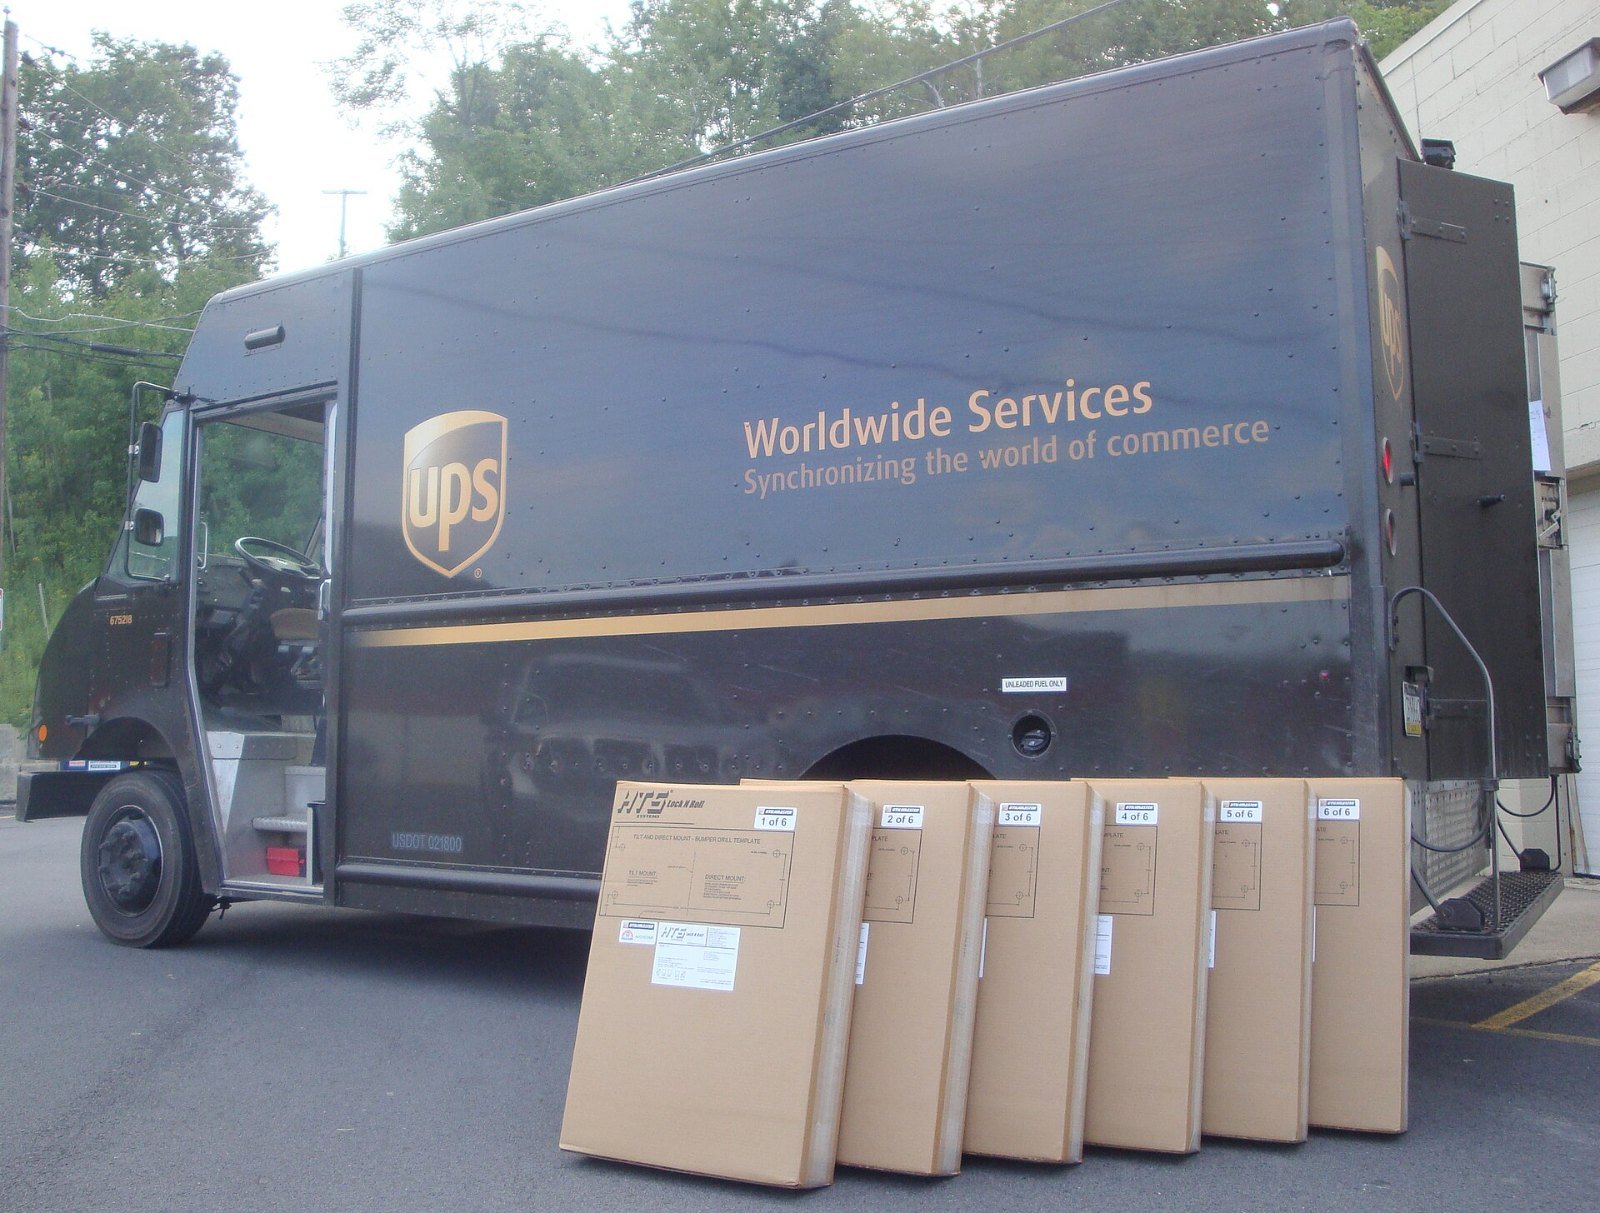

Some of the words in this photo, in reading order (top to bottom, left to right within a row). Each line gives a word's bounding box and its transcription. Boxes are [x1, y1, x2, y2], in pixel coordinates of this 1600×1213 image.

[744, 398, 952, 459] Worldwide
[967, 378, 1153, 433] Services
[744, 453, 917, 500] Synchronizing
[925, 448, 968, 475] the
[979, 435, 1057, 469] world
[1068, 429, 1097, 461] of
[1107, 420, 1270, 457] commerce
[409, 457, 499, 552] ups
[1005, 680, 1034, 688] UNLEADED
[1049, 679, 1064, 687] ONLY
[666, 799, 682, 808] Lock
[689, 800, 705, 809] Roll
[1004, 813, 1011, 821] 3
[1014, 812, 1024, 821] of
[1025, 813, 1032, 821] 6
[1121, 813, 1128, 821] 4
[1130, 812, 1141, 821] of
[1142, 813, 1149, 821] 6
[1226, 810, 1233, 818] 5
[1235, 810, 1245, 818] of
[1247, 810, 1254, 818] 6
[1323, 808, 1330, 816] 6
[1332, 808, 1343, 816] of
[1344, 808, 1351, 816] 6
[761, 817, 766, 826] 1
[769, 817, 779, 826] of
[781, 817, 787, 826] 6
[887, 815, 894, 824] 2
[896, 815, 906, 823] of
[908, 816, 914, 824] 6
[392, 833, 427, 849] USDOT
